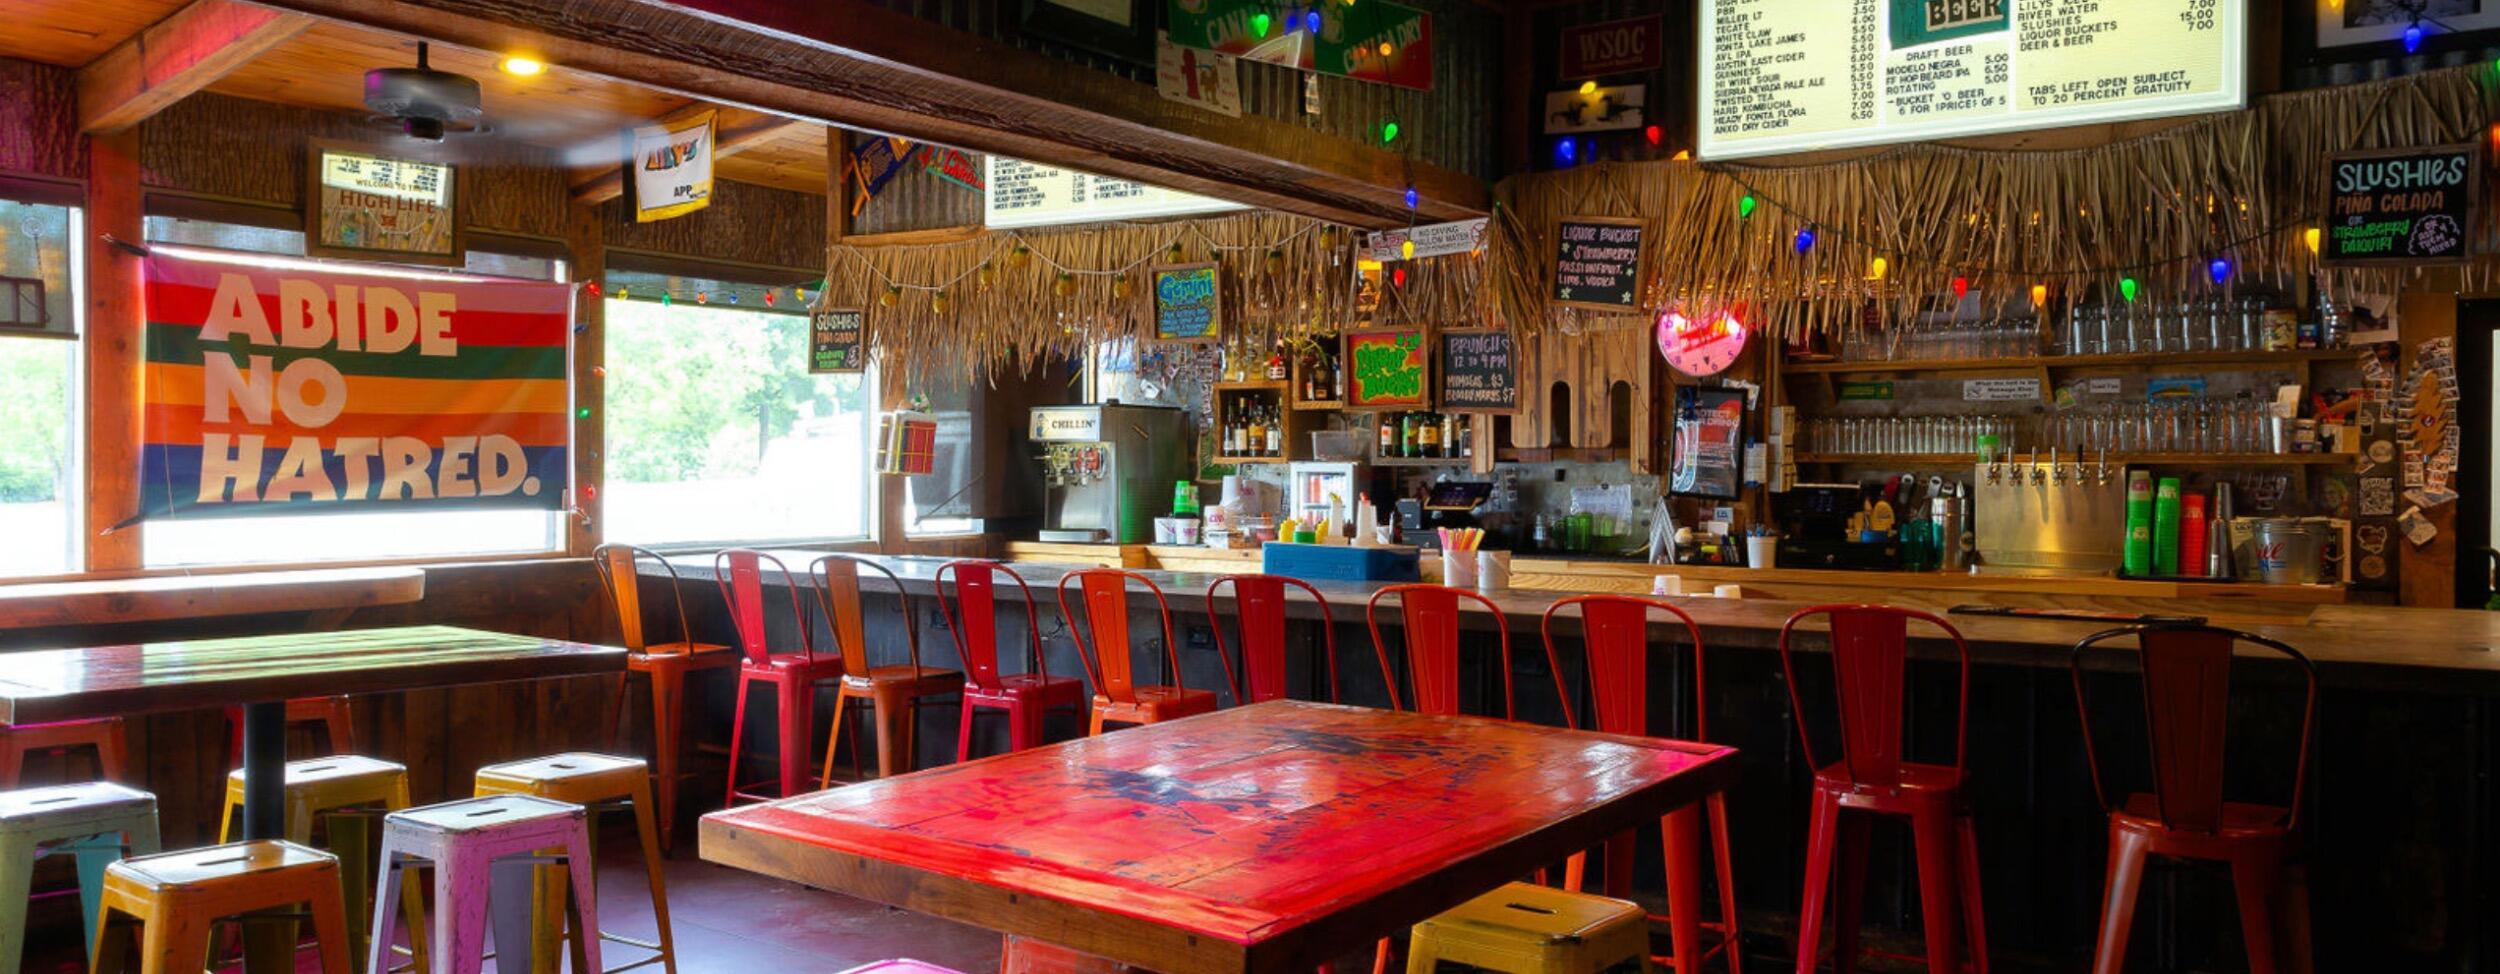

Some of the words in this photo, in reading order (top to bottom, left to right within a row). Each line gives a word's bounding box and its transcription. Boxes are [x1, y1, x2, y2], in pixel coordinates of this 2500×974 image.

[1716, 14, 1748, 25] MILLER
[1753, 11, 1763, 21] LT
[1717, 7, 1735, 16] PBR
[1926, 0, 2004, 32] BEER
[2017, 9, 2052, 22] RIVER
[2058, 3, 2099, 16] WATER
[1715, 23, 1749, 34] TECATE
[2019, 29, 2061, 42] LIQUOR
[2064, 21, 2118, 36] BUCKETS
[2180, 9, 2213, 22] 15.00
[2021, 15, 2082, 31] SLUSHIES
[1580, 26, 1645, 60] WSOC
[1715, 33, 1743, 43] WHITE
[1746, 29, 1771, 39] CLAW
[1749, 38, 1772, 48] LAKE
[1776, 33, 1806, 45] JAMES
[2020, 39, 2049, 52] DEER
[2053, 38, 2060, 48] &
[2063, 35, 2094, 47] BEER
[1906, 49, 1939, 61] DRAFT
[1945, 45, 1973, 56] BEER
[1715, 60, 1747, 71] AUSTIN
[1751, 55, 1773, 66] EAST
[1775, 52, 1805, 63] CIDER
[1886, 63, 1926, 75] MODELO
[1928, 59, 1961, 70] NEGRA
[1715, 68, 1761, 79] GUINNESS
[1756, 74, 1781, 83] SOUR
[1715, 88, 1746, 98] SIERRA
[1749, 82, 1781, 93] NEVADA
[1783, 79, 1804, 89] PALE
[1808, 77, 1825, 87] ALE
[1886, 81, 1935, 95] ROTATING
[2029, 85, 2057, 96] TABS
[2062, 81, 2089, 92] LEFT
[2097, 76, 2128, 88] OPEN
[2133, 70, 2186, 85] SUBJECT
[1715, 95, 1753, 106] TWISTED
[1757, 93, 1774, 101] TEA
[1958, 88, 1985, 99] BEER
[2032, 95, 2047, 106] TO
[2053, 93, 2068, 104] 20
[2073, 86, 2127, 101] PERCENT
[2133, 80, 2192, 96] GRATUITY
[1713, 106, 1738, 116] HARD
[1742, 100, 1792, 112] KOMBUCHA
[1778, 107, 1807, 117] FLORA
[1910, 104, 1930, 114] FOR
[1981, 97, 1994, 107] OF
[1999, 95, 2006, 105] 5
[1742, 122, 1759, 131] DRY
[1761, 118, 1789, 128] CIDER
[340, 189, 391, 209] HIGH
[397, 195, 437, 214] LIFE
[2381, 191, 2444, 213] COLADA
[197, 272, 458, 357] ABIDE
[1450, 335, 1500, 355] BRUNCH
[1490, 353, 1507, 368] PM
[202, 350, 348, 429] NO
[1051, 420, 1097, 429] CHILLIN'
[196, 432, 541, 503] HATRED.
